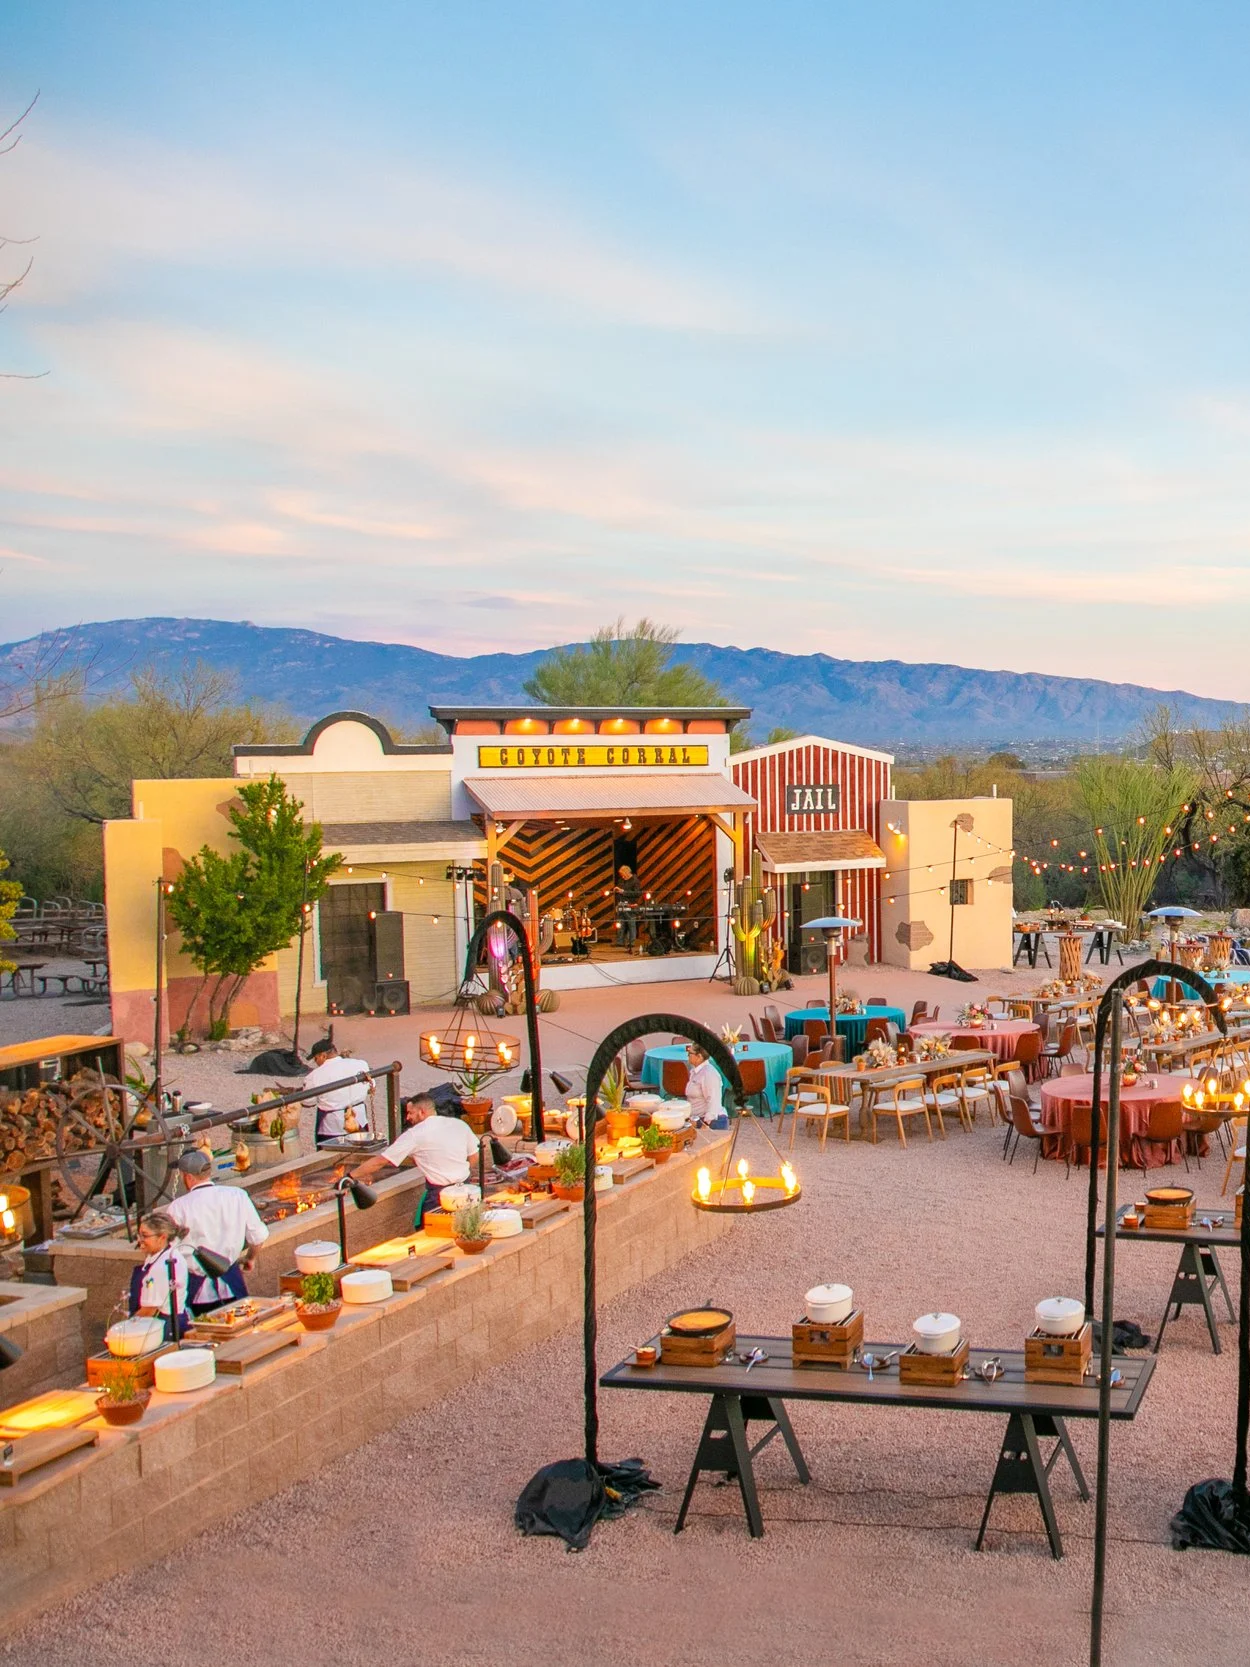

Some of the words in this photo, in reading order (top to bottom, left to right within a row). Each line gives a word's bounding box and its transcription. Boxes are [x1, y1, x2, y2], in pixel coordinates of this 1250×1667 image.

[500, 748, 586, 765] COYOTE
[606, 747, 691, 765] CORRAL
[791, 788, 836, 811] JAIL
